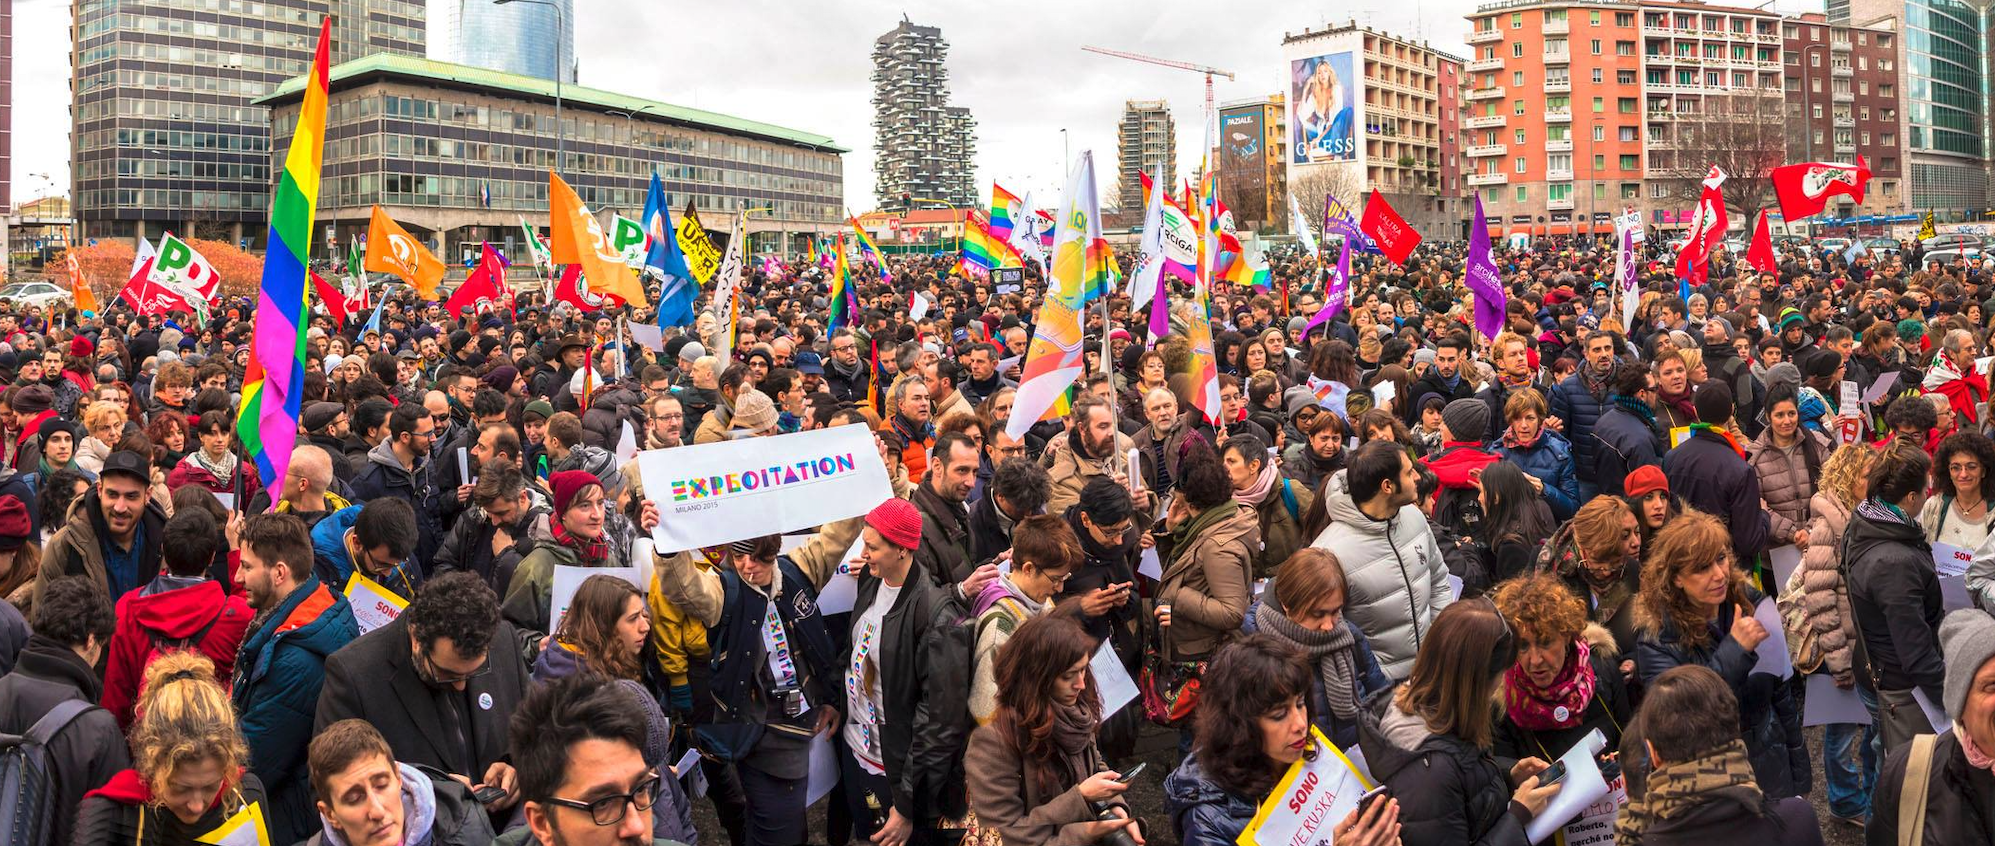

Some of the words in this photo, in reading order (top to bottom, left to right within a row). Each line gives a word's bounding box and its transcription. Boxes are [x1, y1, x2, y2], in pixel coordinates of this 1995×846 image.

[683, 222, 714, 274] UAR
[675, 504, 702, 514] MILANO
[703, 501, 719, 510] 2015
[1954, 551, 1972, 562] SON
[1288, 771, 1319, 815] SONO
[1568, 821, 1608, 835] Roberto,
